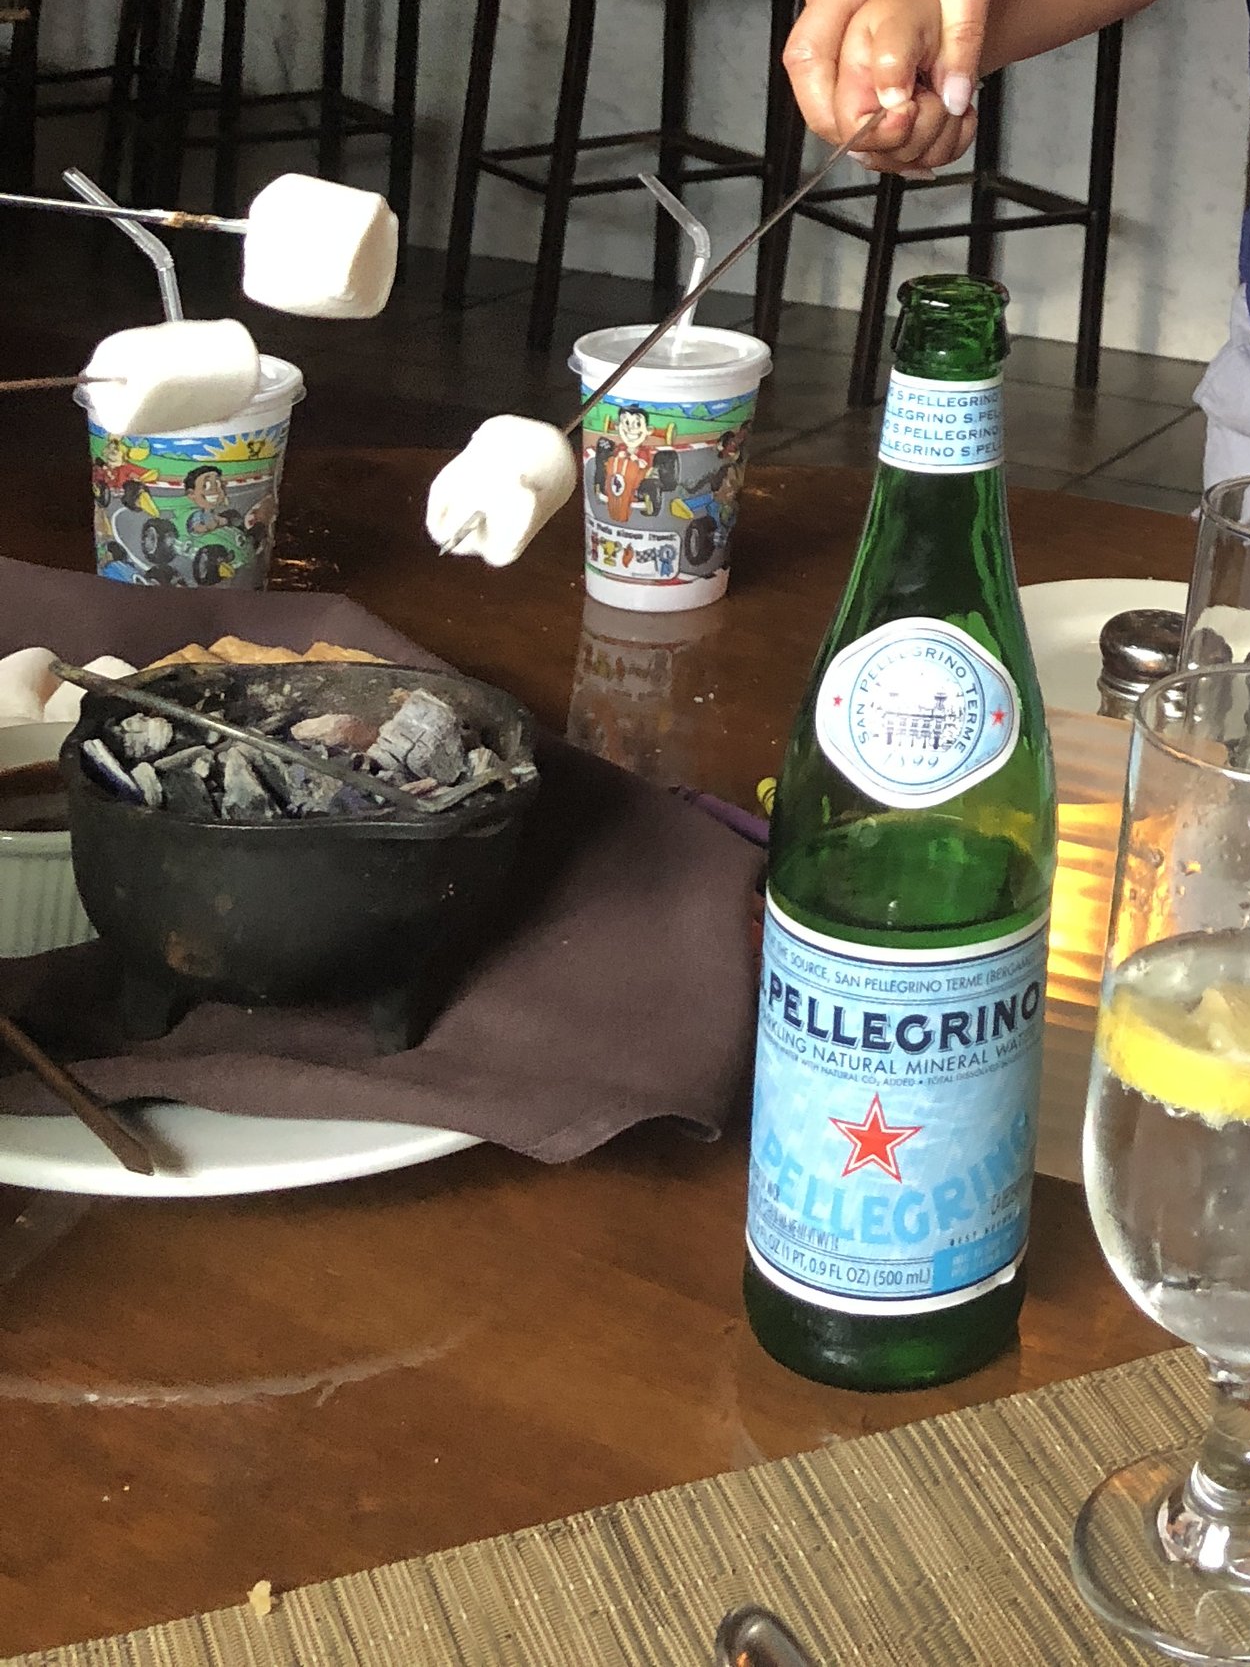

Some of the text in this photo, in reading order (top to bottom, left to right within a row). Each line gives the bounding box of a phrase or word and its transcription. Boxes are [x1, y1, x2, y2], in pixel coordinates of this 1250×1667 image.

[963, 413, 973, 424] S
[904, 425, 999, 440] PELLEGRINO
[961, 446, 971, 457] S
[856, 703, 870, 745] SAN
[955, 682, 979, 754] TERME
[835, 971, 860, 988] SAN
[864, 978, 942, 994] PELLEGRINO
[946, 973, 983, 992] TERME
[769, 970, 1040, 1056] PELLEGRINO
[813, 1044, 897, 1075] NATURAL
[905, 1050, 989, 1075] MINERAL
[882, 1077, 915, 1086] ADDED
[808, 1258, 827, 1276] 0.9
[829, 1263, 842, 1280] FL
[846, 1266, 871, 1286] OZ)
[874, 1270, 904, 1287] (500
[906, 1268, 932, 1284] mL)
